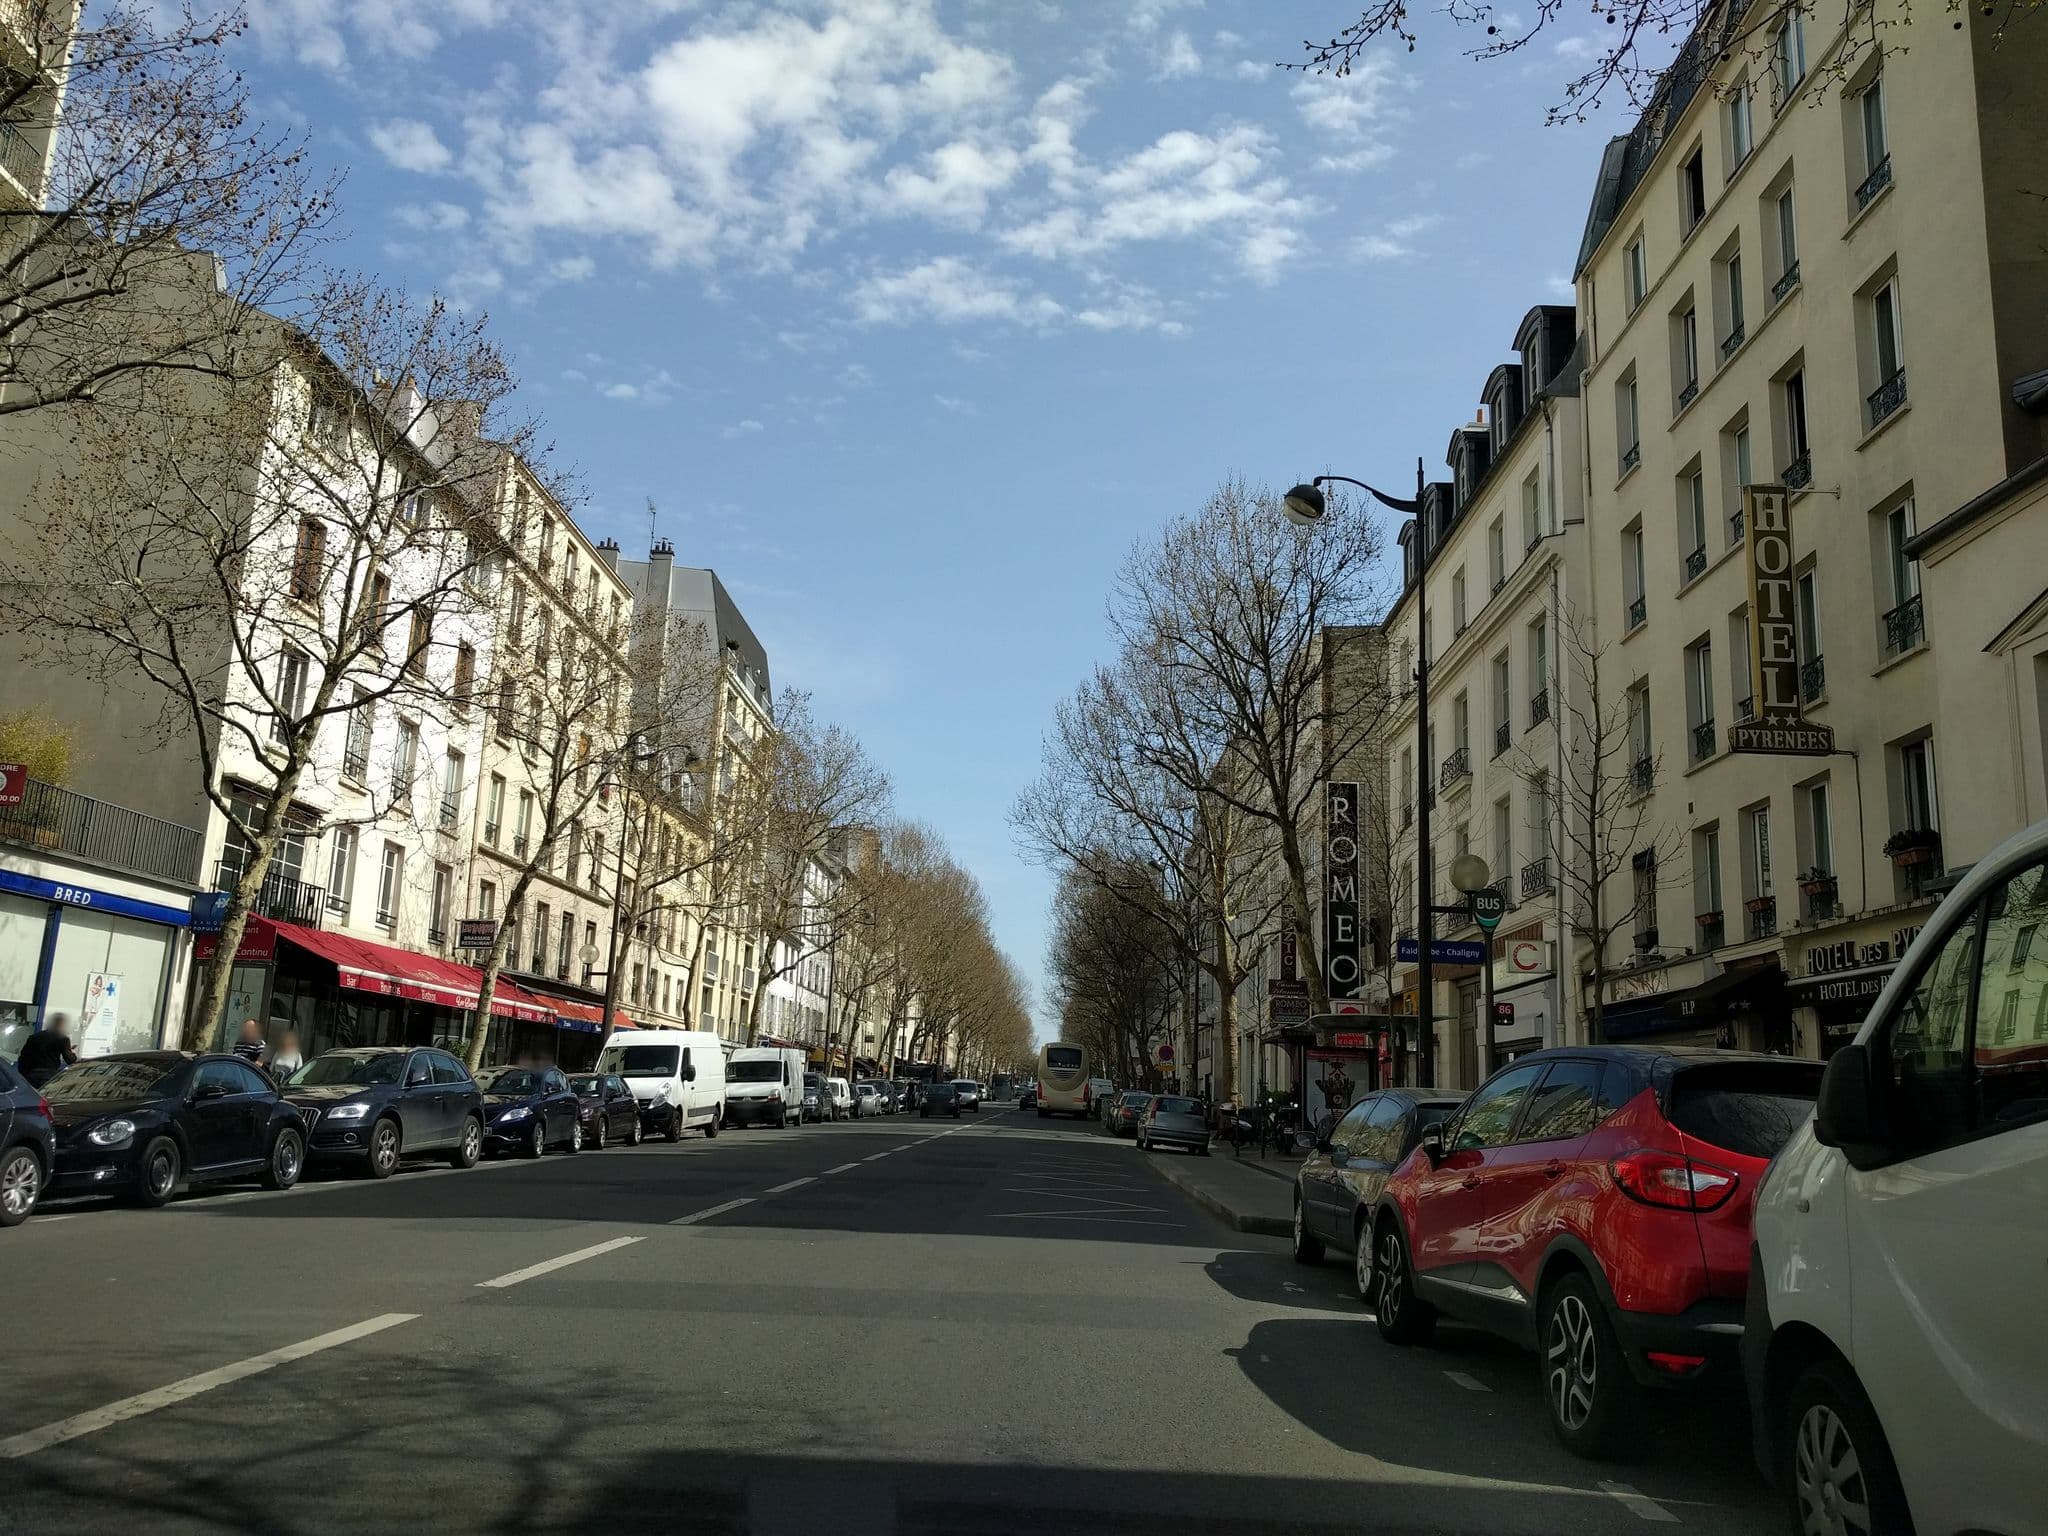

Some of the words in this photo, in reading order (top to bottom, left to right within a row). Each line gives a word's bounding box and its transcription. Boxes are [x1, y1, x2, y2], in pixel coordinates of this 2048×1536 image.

[1752, 493, 1798, 708] HOTEL
[1737, 728, 1830, 750] PYRENEES
[53, 886, 92, 905] BRED
[1329, 796, 1359, 983] ROMEO
[1476, 897, 1501, 910] BUS
[1446, 948, 1480, 958] Chaligny
[1807, 940, 1854, 974] HOTEL
[1860, 943, 1883, 963] DES
[1819, 980, 1859, 1001] HOTEL
[1860, 980, 1880, 995] DES
[1498, 1005, 1512, 1015] 86
